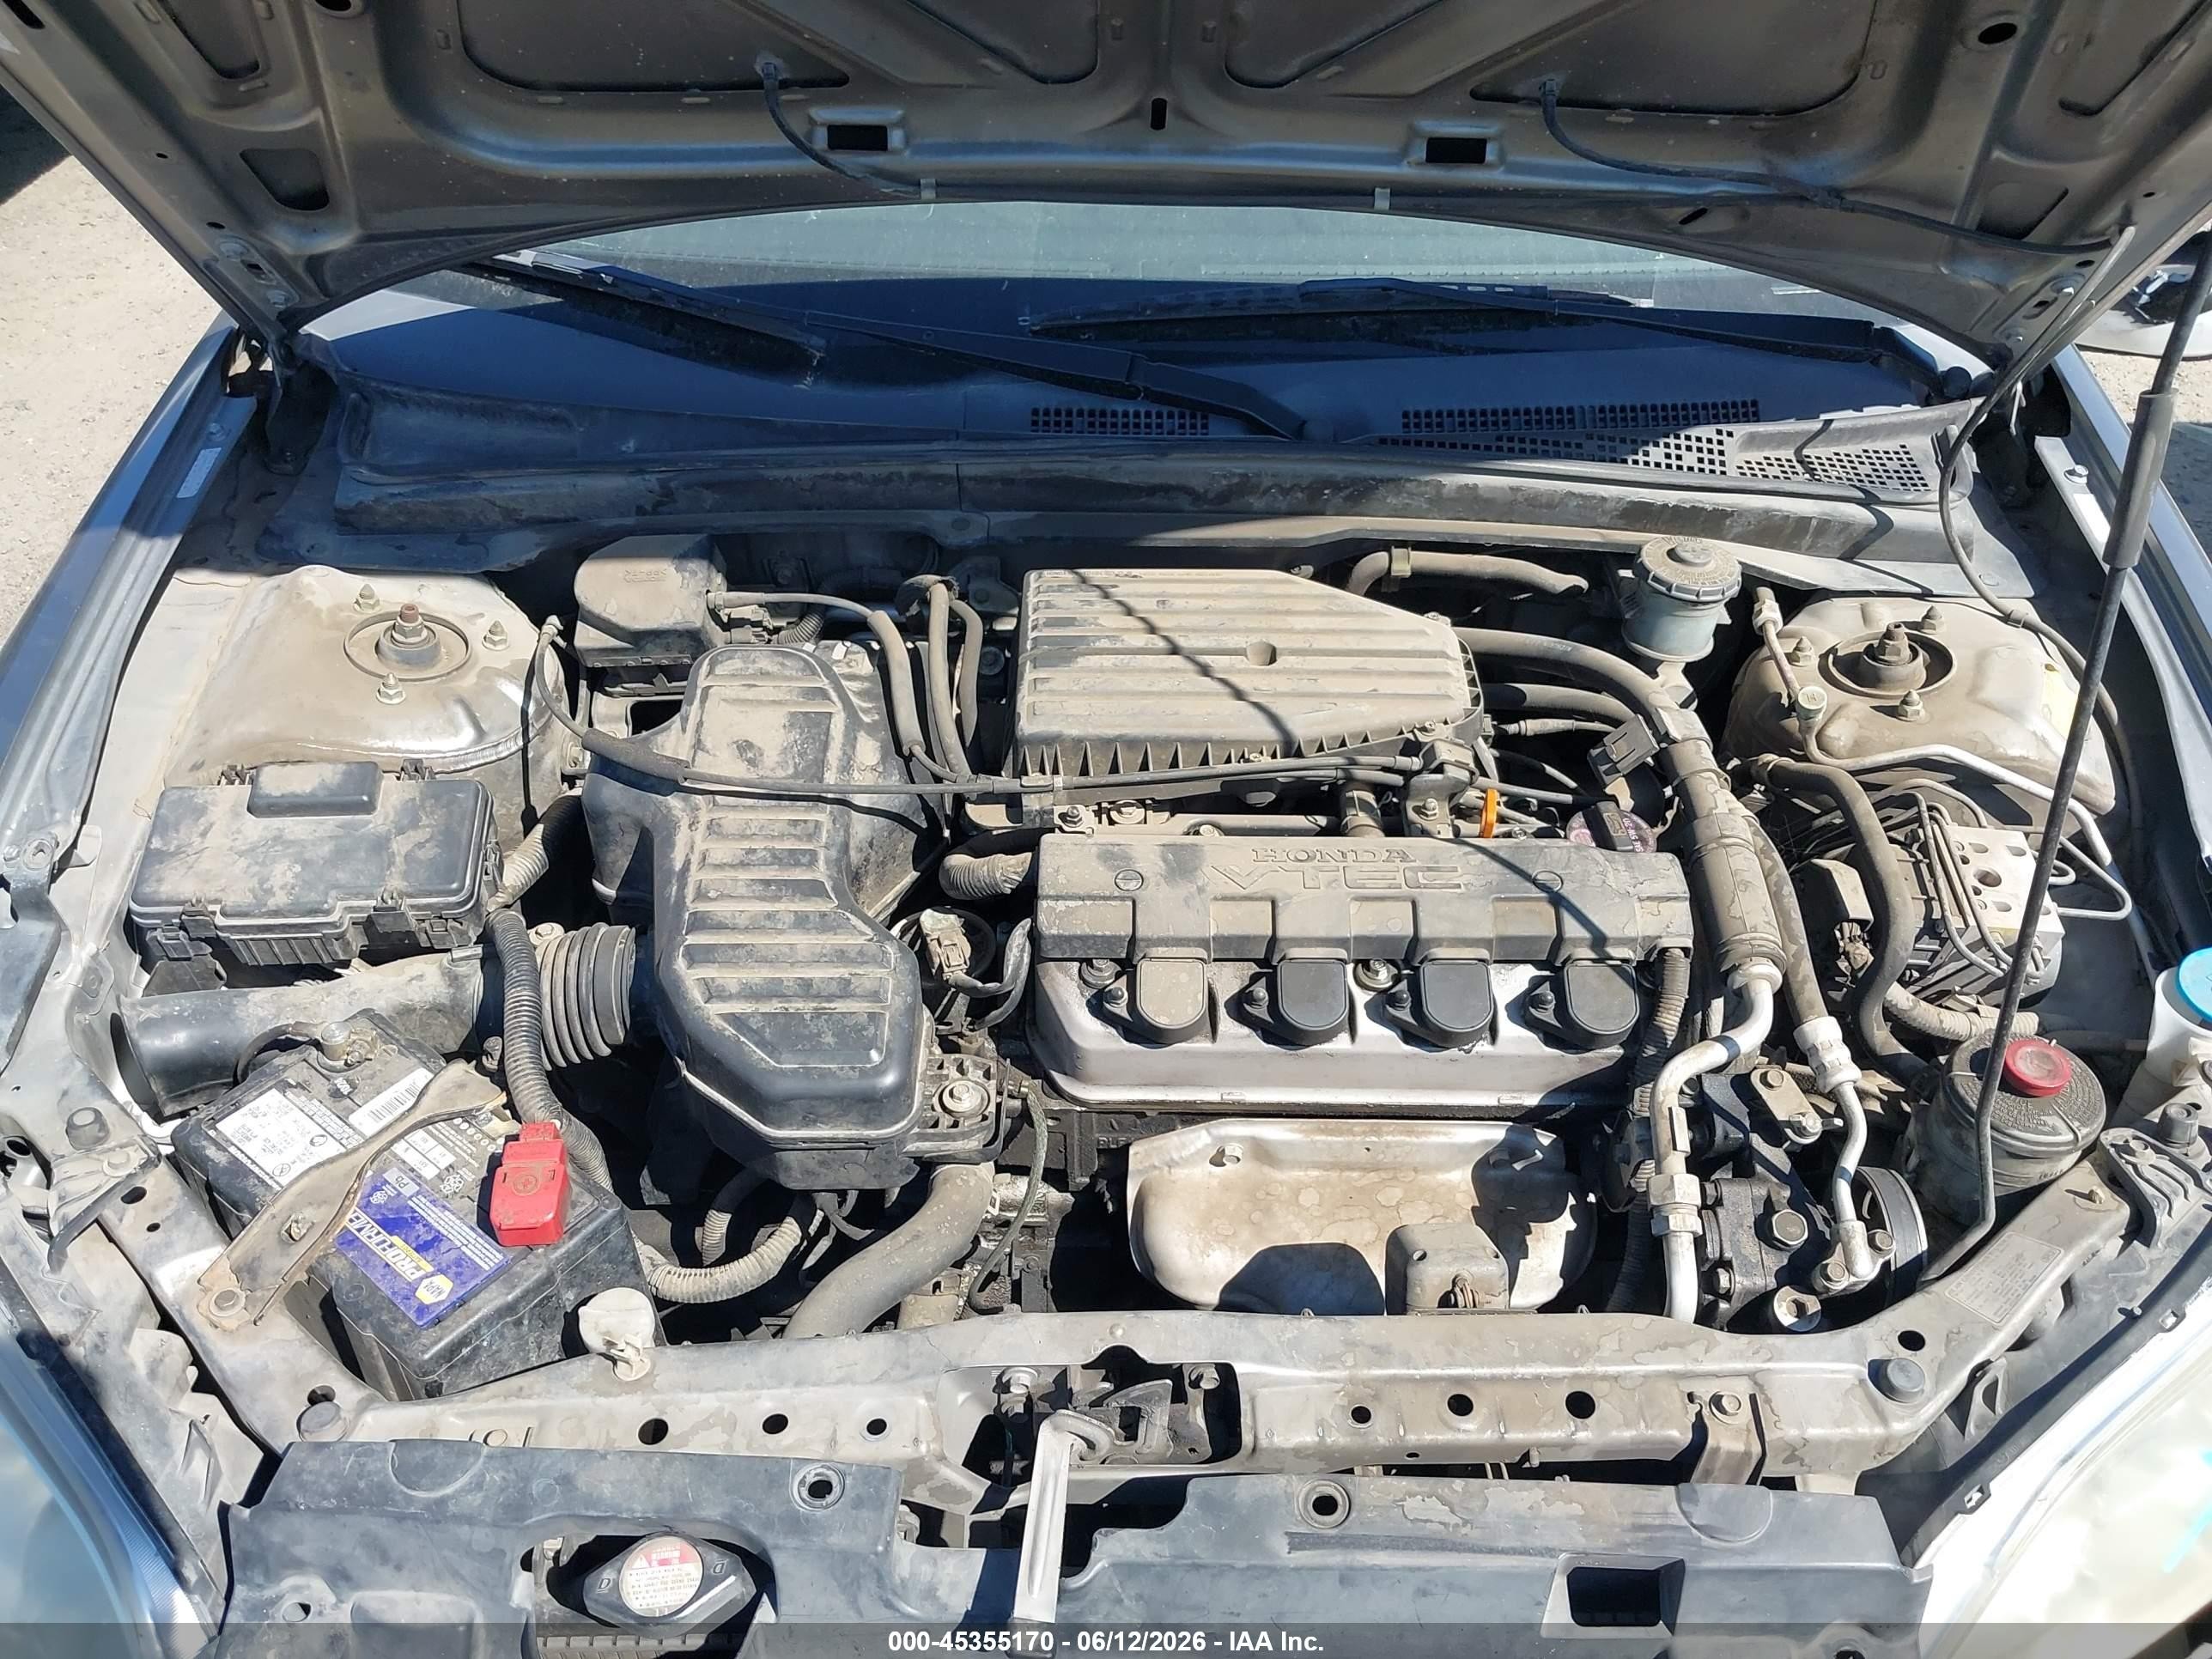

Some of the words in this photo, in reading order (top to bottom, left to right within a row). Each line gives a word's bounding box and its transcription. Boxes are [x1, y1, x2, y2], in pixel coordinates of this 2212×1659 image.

[1632, 841, 1644, 852] SAE
[1251, 848, 1417, 863] HONDA
[1202, 865, 1463, 891] VTEC
[395, 1176, 410, 1189] Pb
[344, 1208, 428, 1281] PROFORME
[423, 1279, 446, 1298] NAPA
